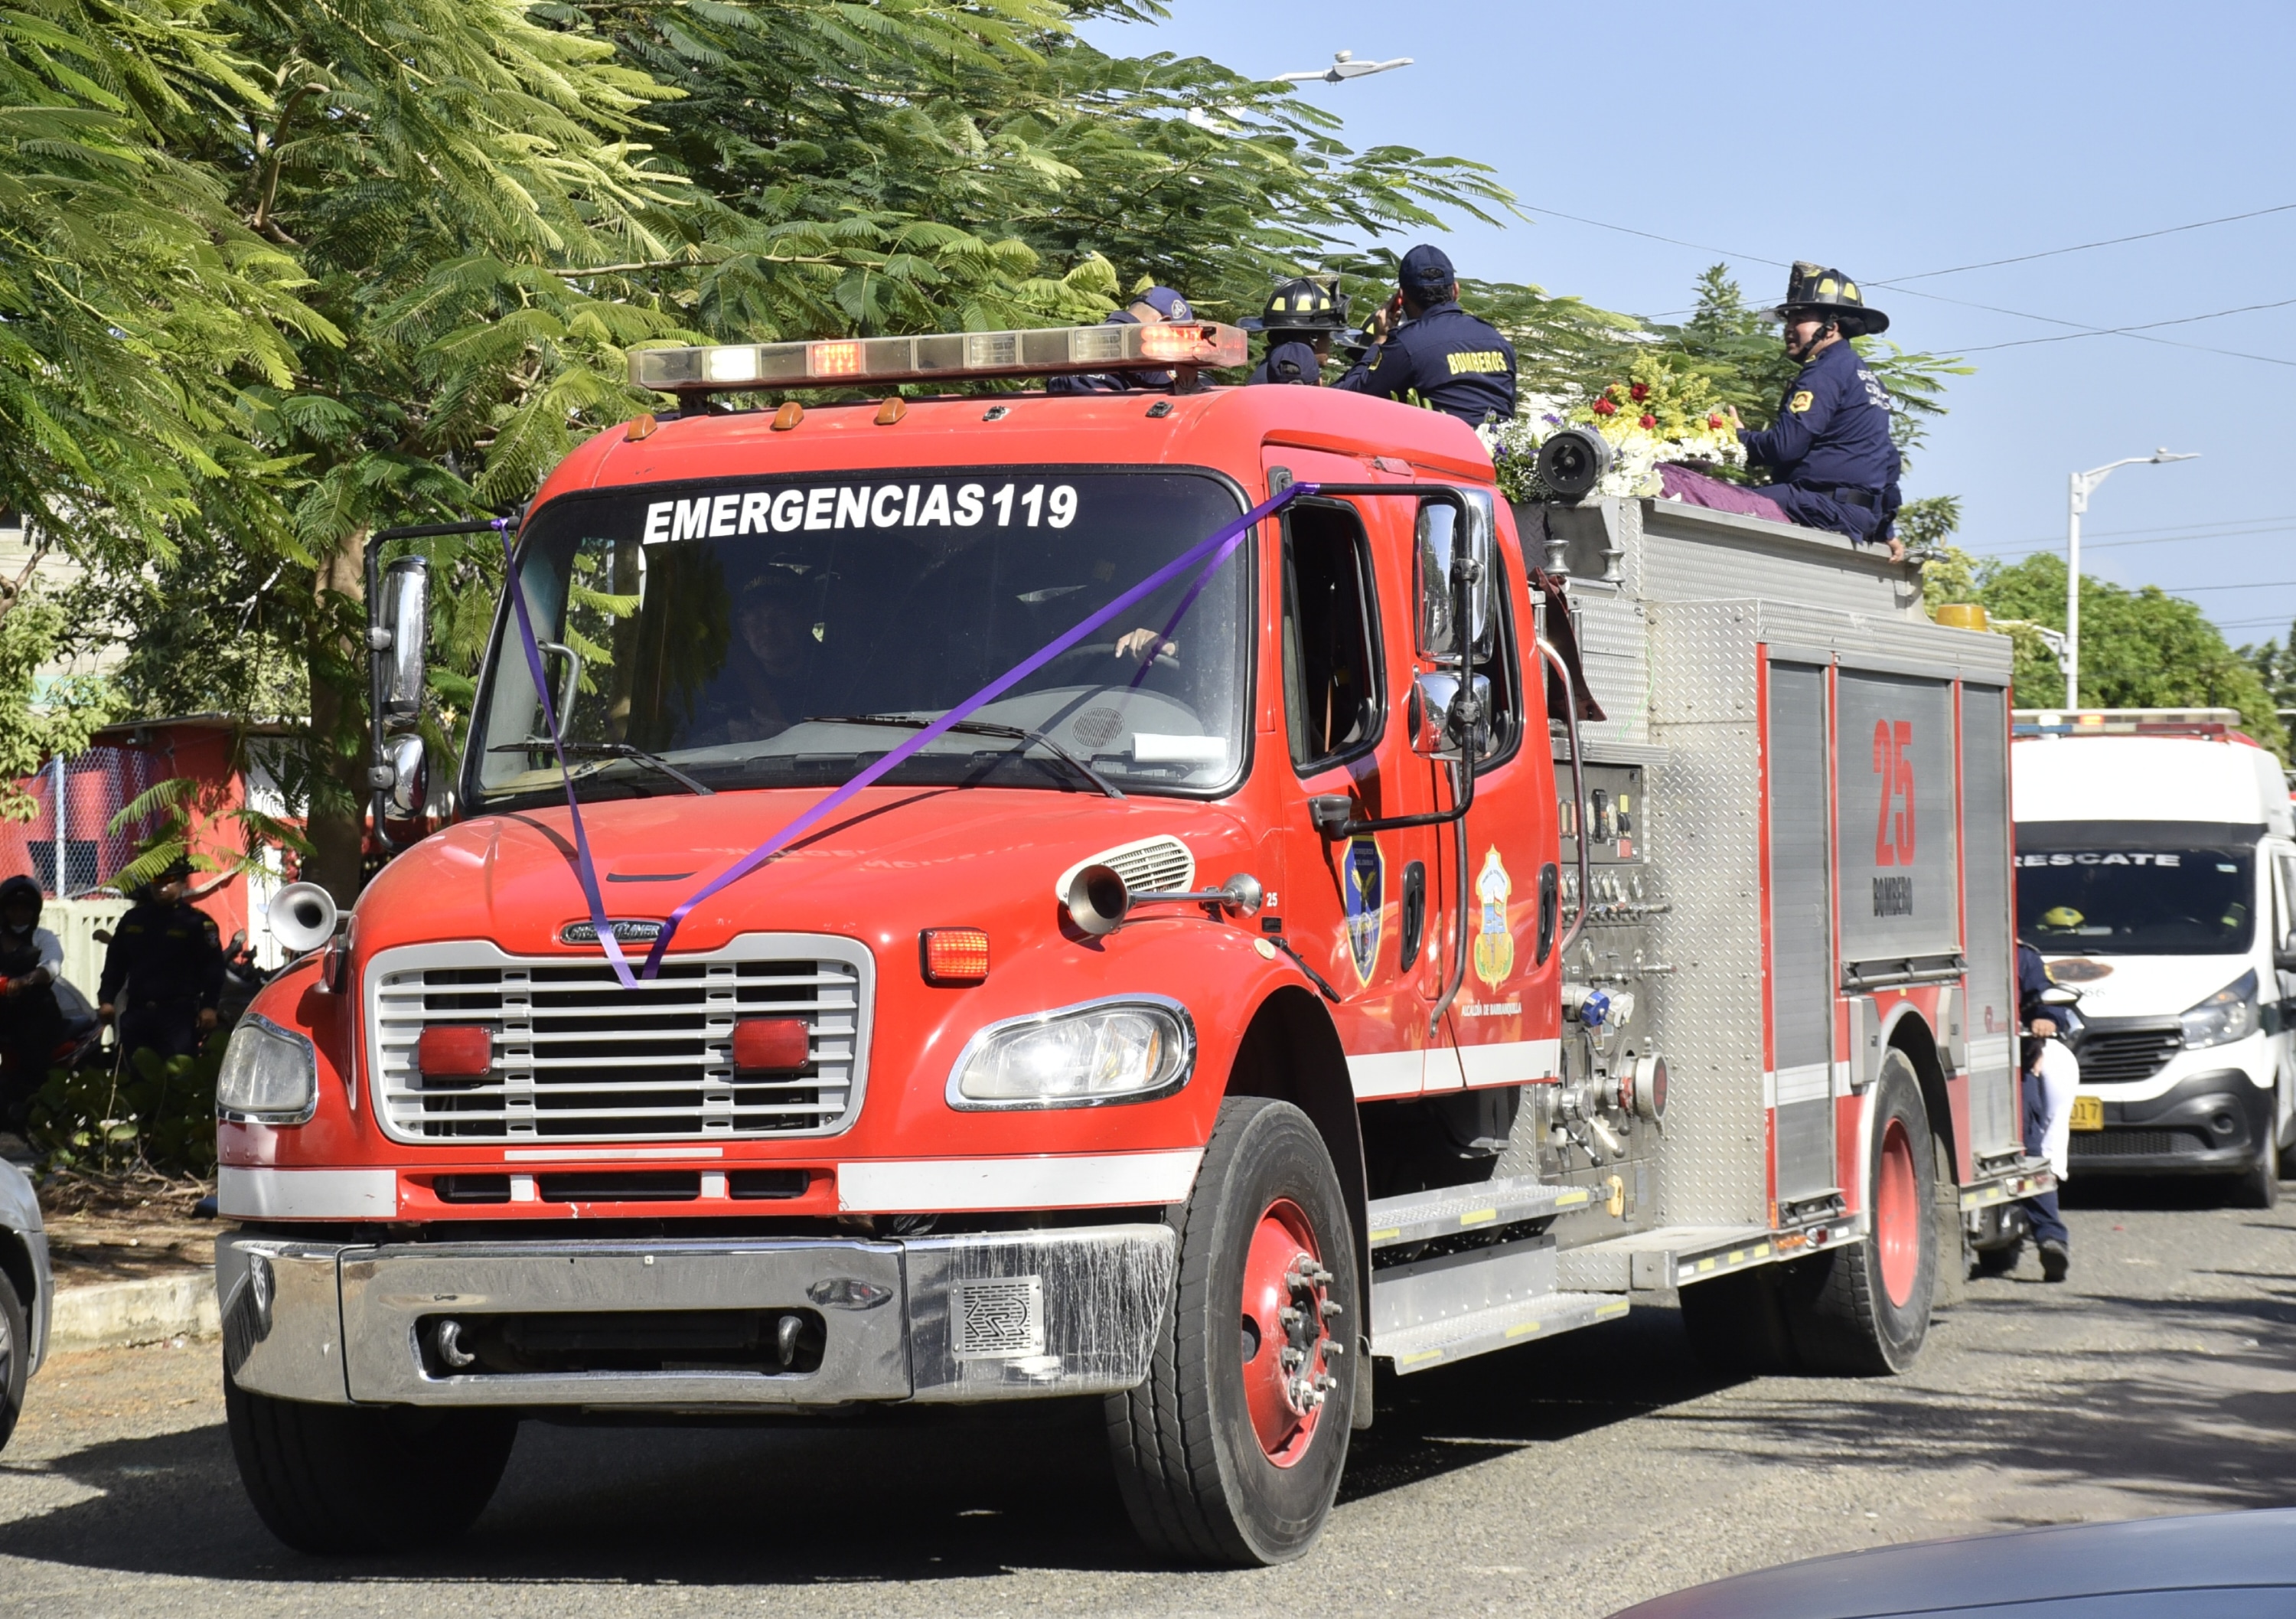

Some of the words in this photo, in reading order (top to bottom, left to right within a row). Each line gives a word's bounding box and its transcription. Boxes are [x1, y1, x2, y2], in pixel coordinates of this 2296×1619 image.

[1446, 351, 1508, 375] BOMBEROS
[643, 484, 985, 545] EMERGENCIAS
[992, 484, 1078, 528] 119
[1873, 719, 1916, 867] 25
[1266, 892, 1278, 907] 25
